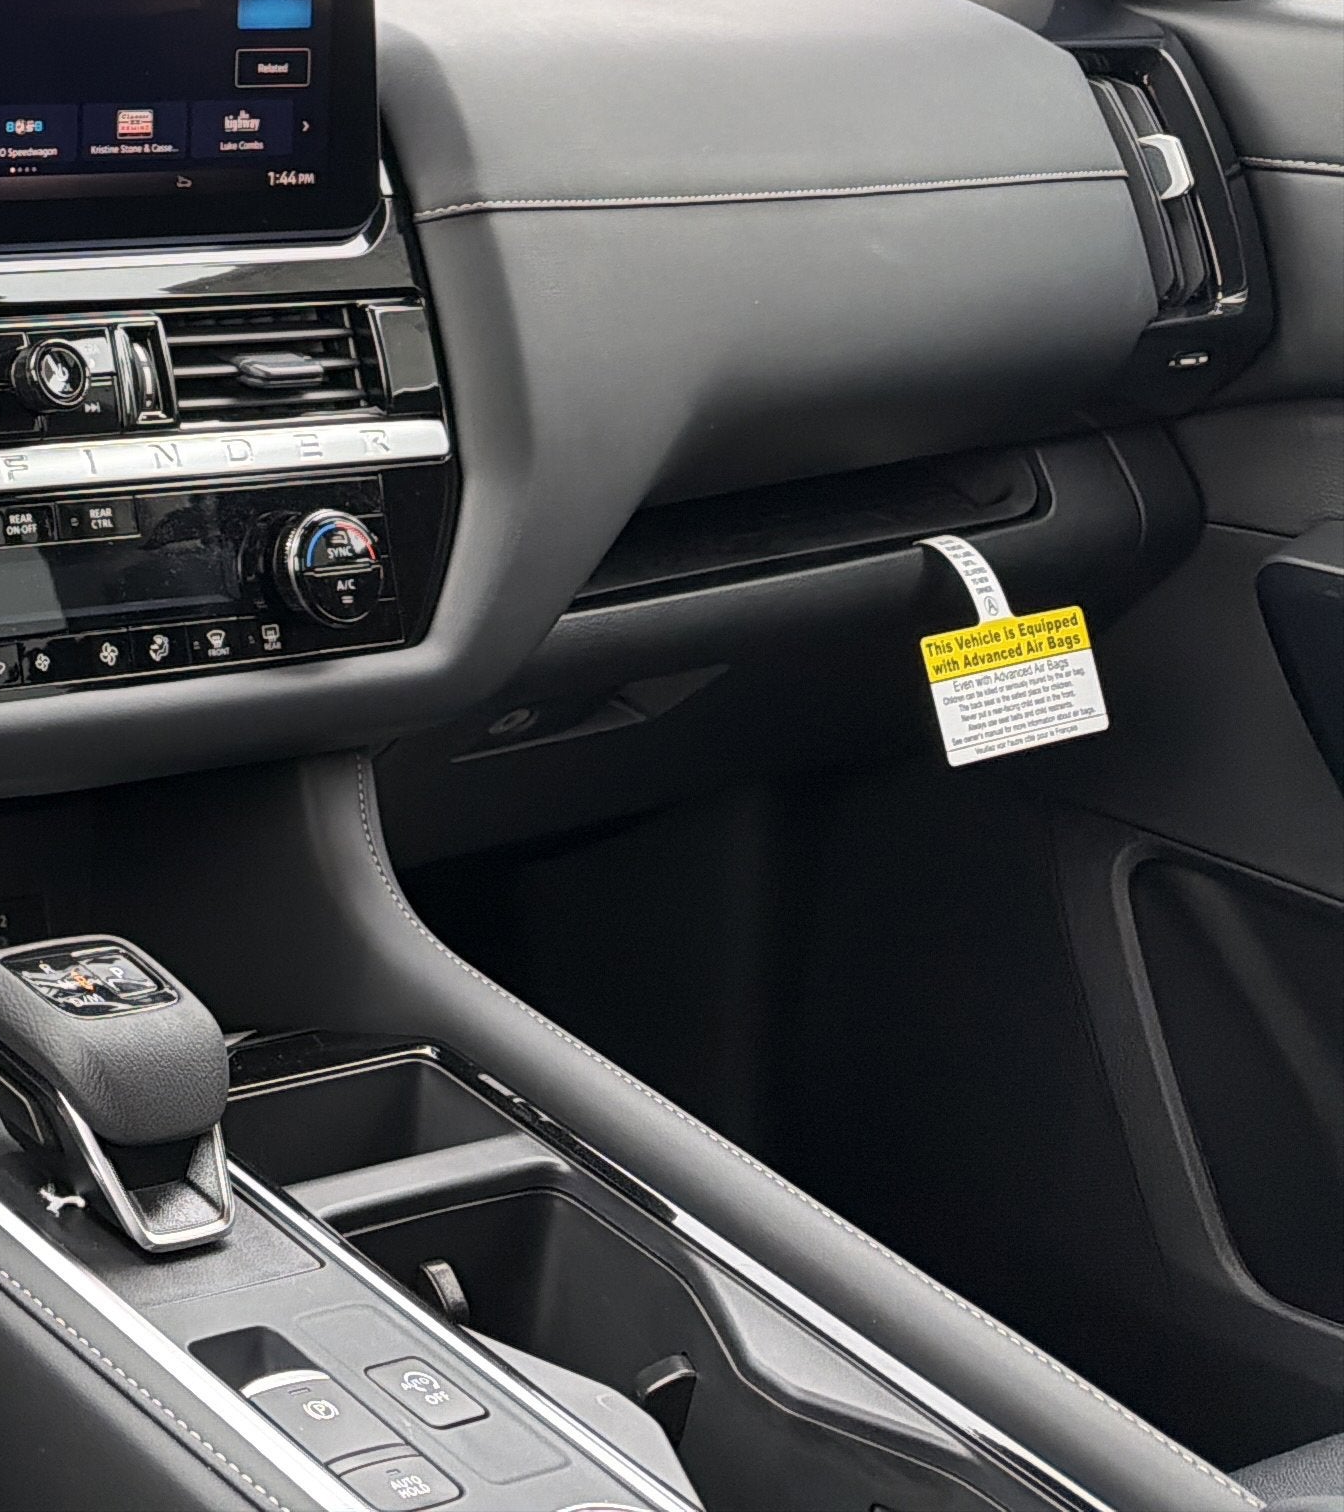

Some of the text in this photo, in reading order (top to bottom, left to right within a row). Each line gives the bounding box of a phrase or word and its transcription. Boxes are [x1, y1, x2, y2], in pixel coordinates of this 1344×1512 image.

[257, 63, 288, 74] Related
[267, 171, 315, 186] 1:44 PM
[9, 513, 33, 524] REAR
[89, 507, 113, 518] REAR
[90, 518, 114, 530] CTRL
[326, 545, 353, 559] SYNC
[336, 578, 356, 592] A/C
[925, 612, 1079, 657] This Vehicle is Equipped
[207, 647, 230, 657] FRONT
[932, 633, 1081, 675] with Advanced Air Bags
[953, 678, 974, 692] Even
[993, 666, 1033, 684] Advanced
[1034, 661, 1046, 674] Air
[1047, 657, 1069, 672] Bags
[109, 967, 124, 978] P
[425, 1390, 449, 1405] OFF
[390, 1475, 422, 1491] AUTO
[398, 1483, 431, 1499] HOLD
